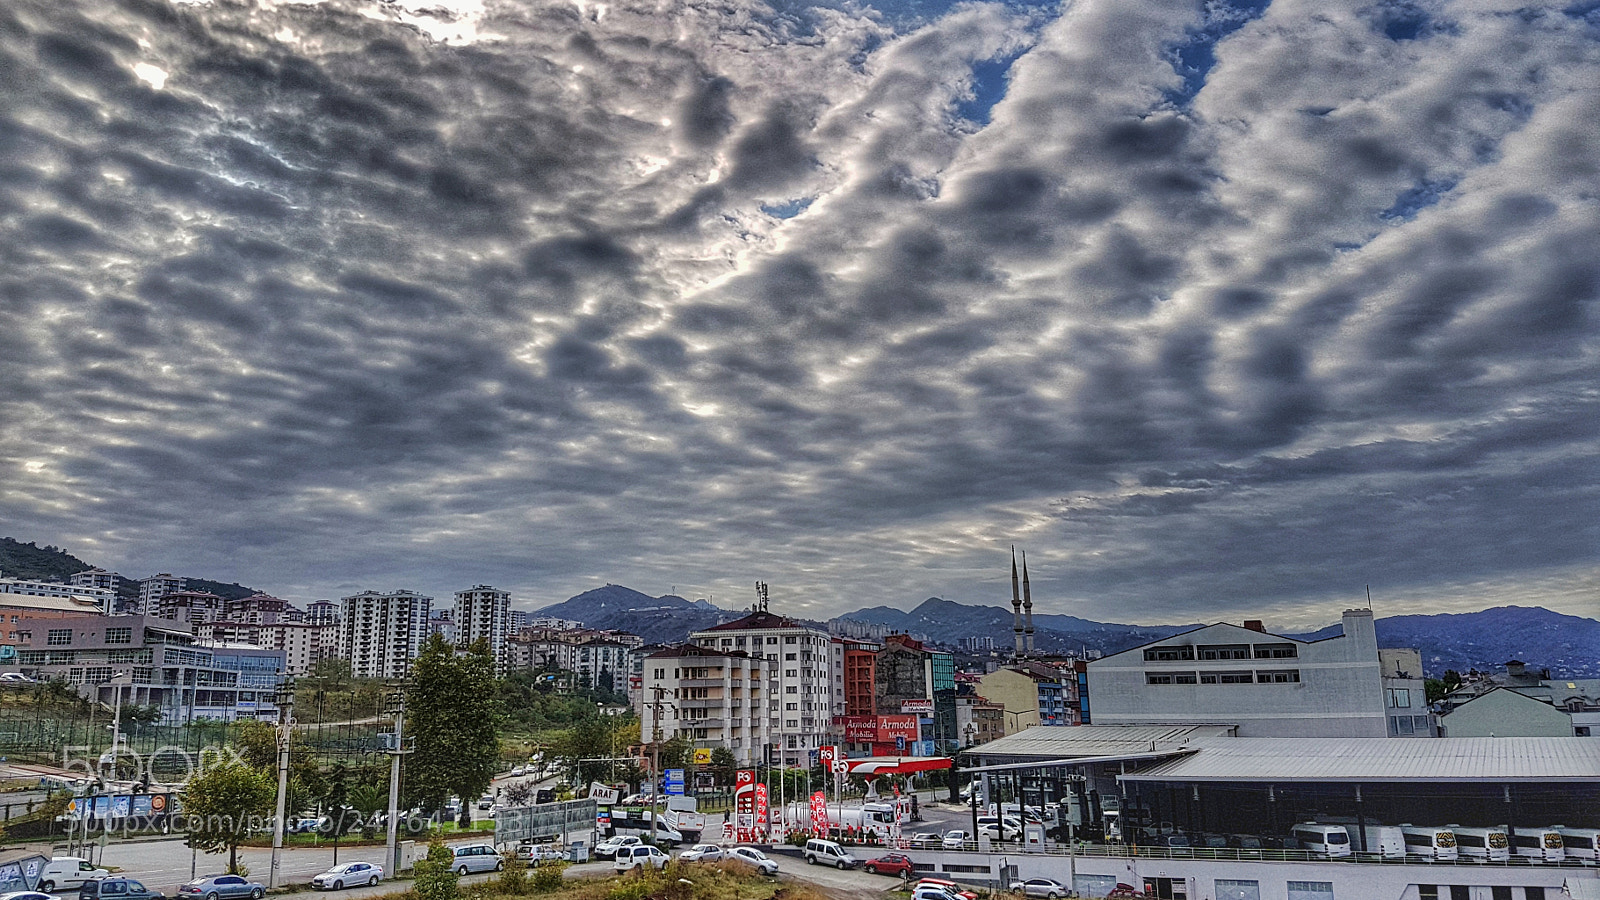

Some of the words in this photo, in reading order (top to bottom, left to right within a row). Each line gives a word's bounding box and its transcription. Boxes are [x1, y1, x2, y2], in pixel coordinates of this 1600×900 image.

[847, 719, 877, 729] Armoda
[880, 718, 915, 729] Armoda
[592, 788, 614, 799] ARAF
